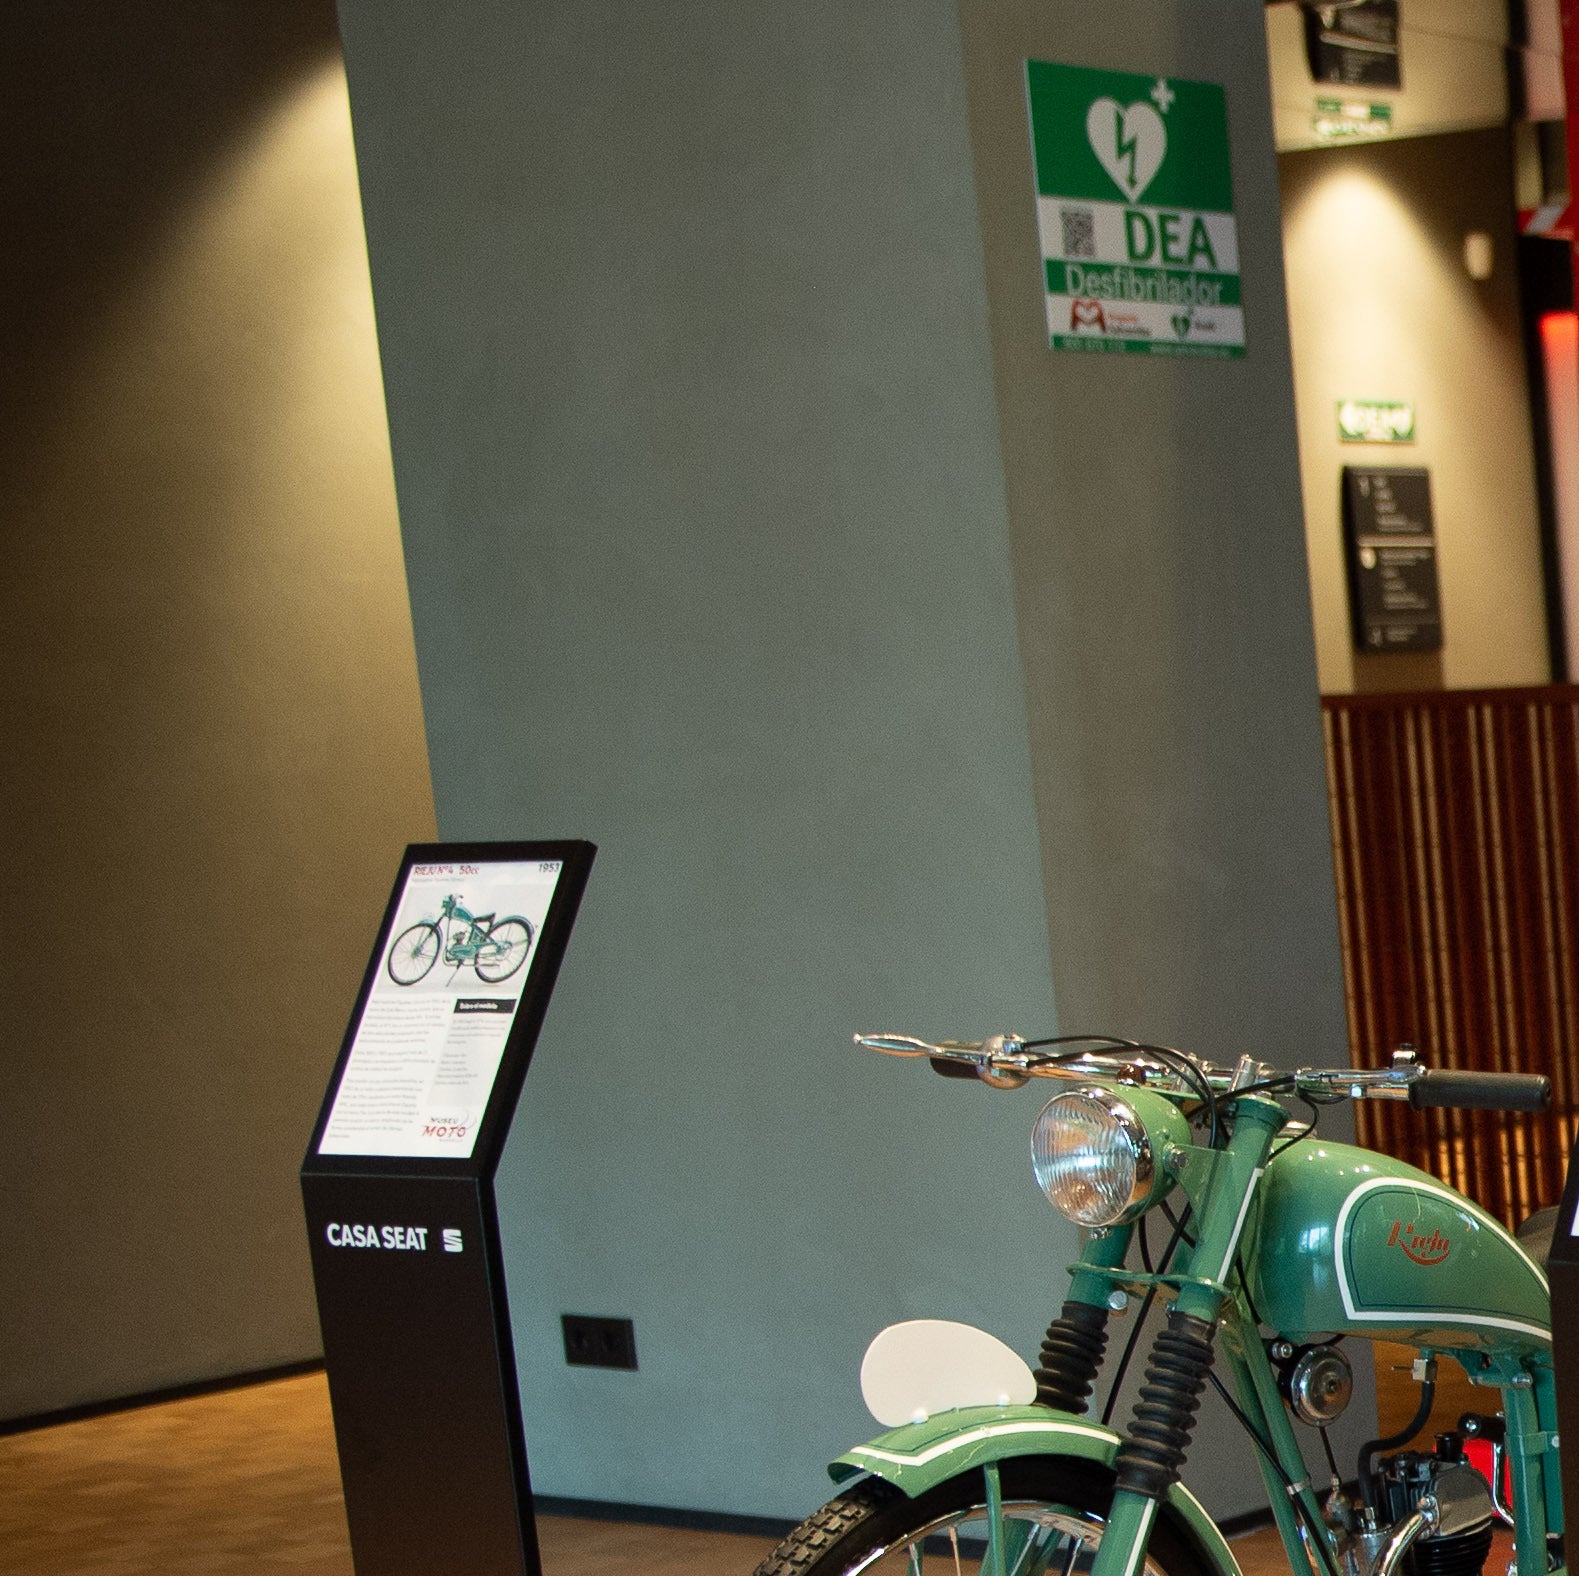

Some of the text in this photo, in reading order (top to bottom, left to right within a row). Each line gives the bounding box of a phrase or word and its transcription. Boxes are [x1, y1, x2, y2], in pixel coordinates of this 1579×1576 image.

[1123, 209, 1217, 270] DEA
[1065, 264, 1223, 308] Desfibrilador
[459, 865, 480, 875] 50cc
[538, 863, 560, 873] 1953
[421, 1125, 466, 1138] MOTO
[326, 1223, 428, 1251] CASA SEAT
